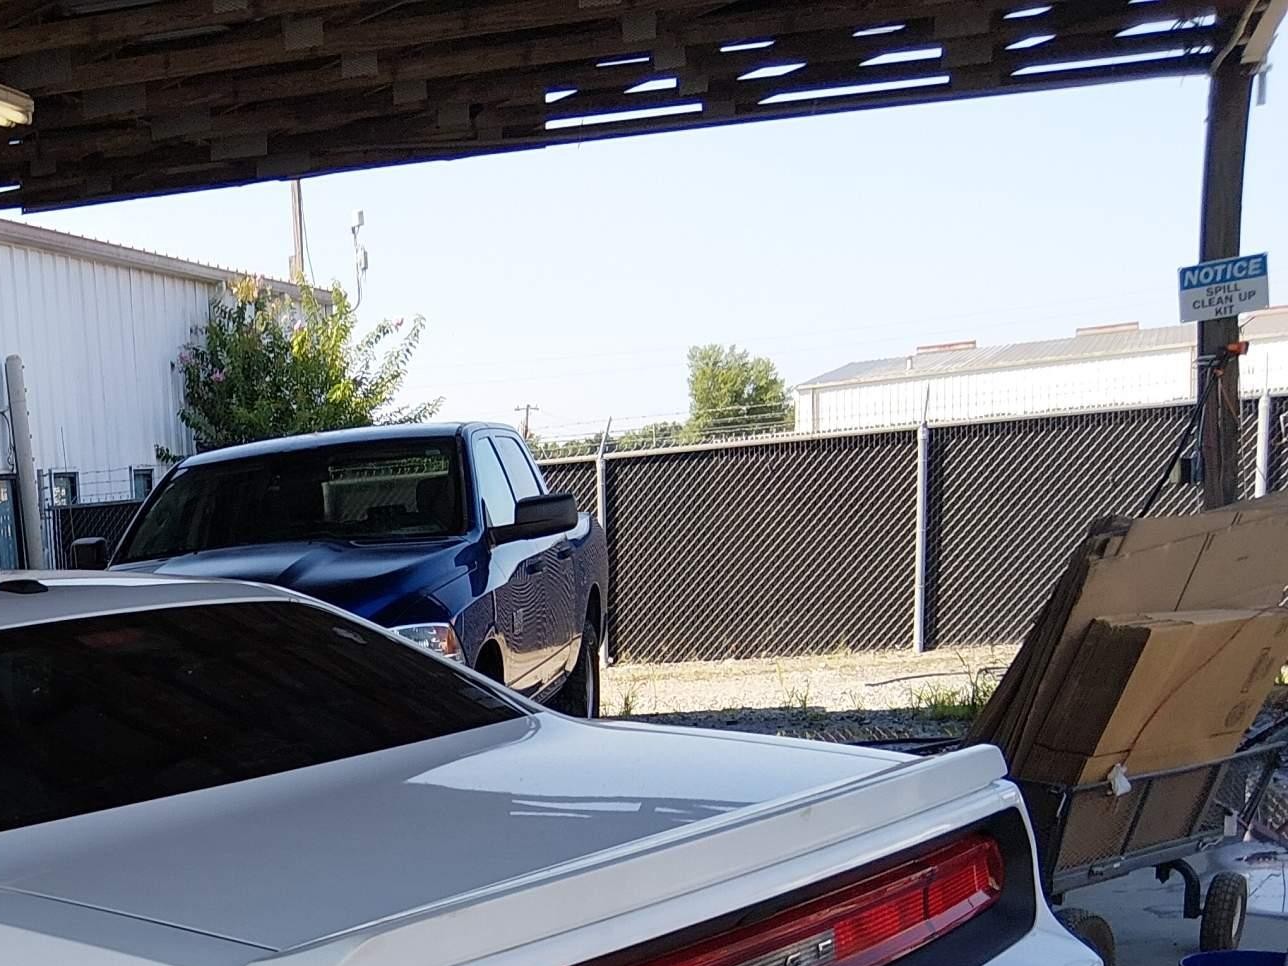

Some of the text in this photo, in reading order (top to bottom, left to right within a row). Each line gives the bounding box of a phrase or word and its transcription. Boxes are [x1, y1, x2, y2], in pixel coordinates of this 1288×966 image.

[1183, 257, 1263, 288] NOTICE
[1206, 282, 1241, 297] SPILL
[1192, 290, 1256, 310] CLEAN UP
[1214, 304, 1234, 317] KIT
